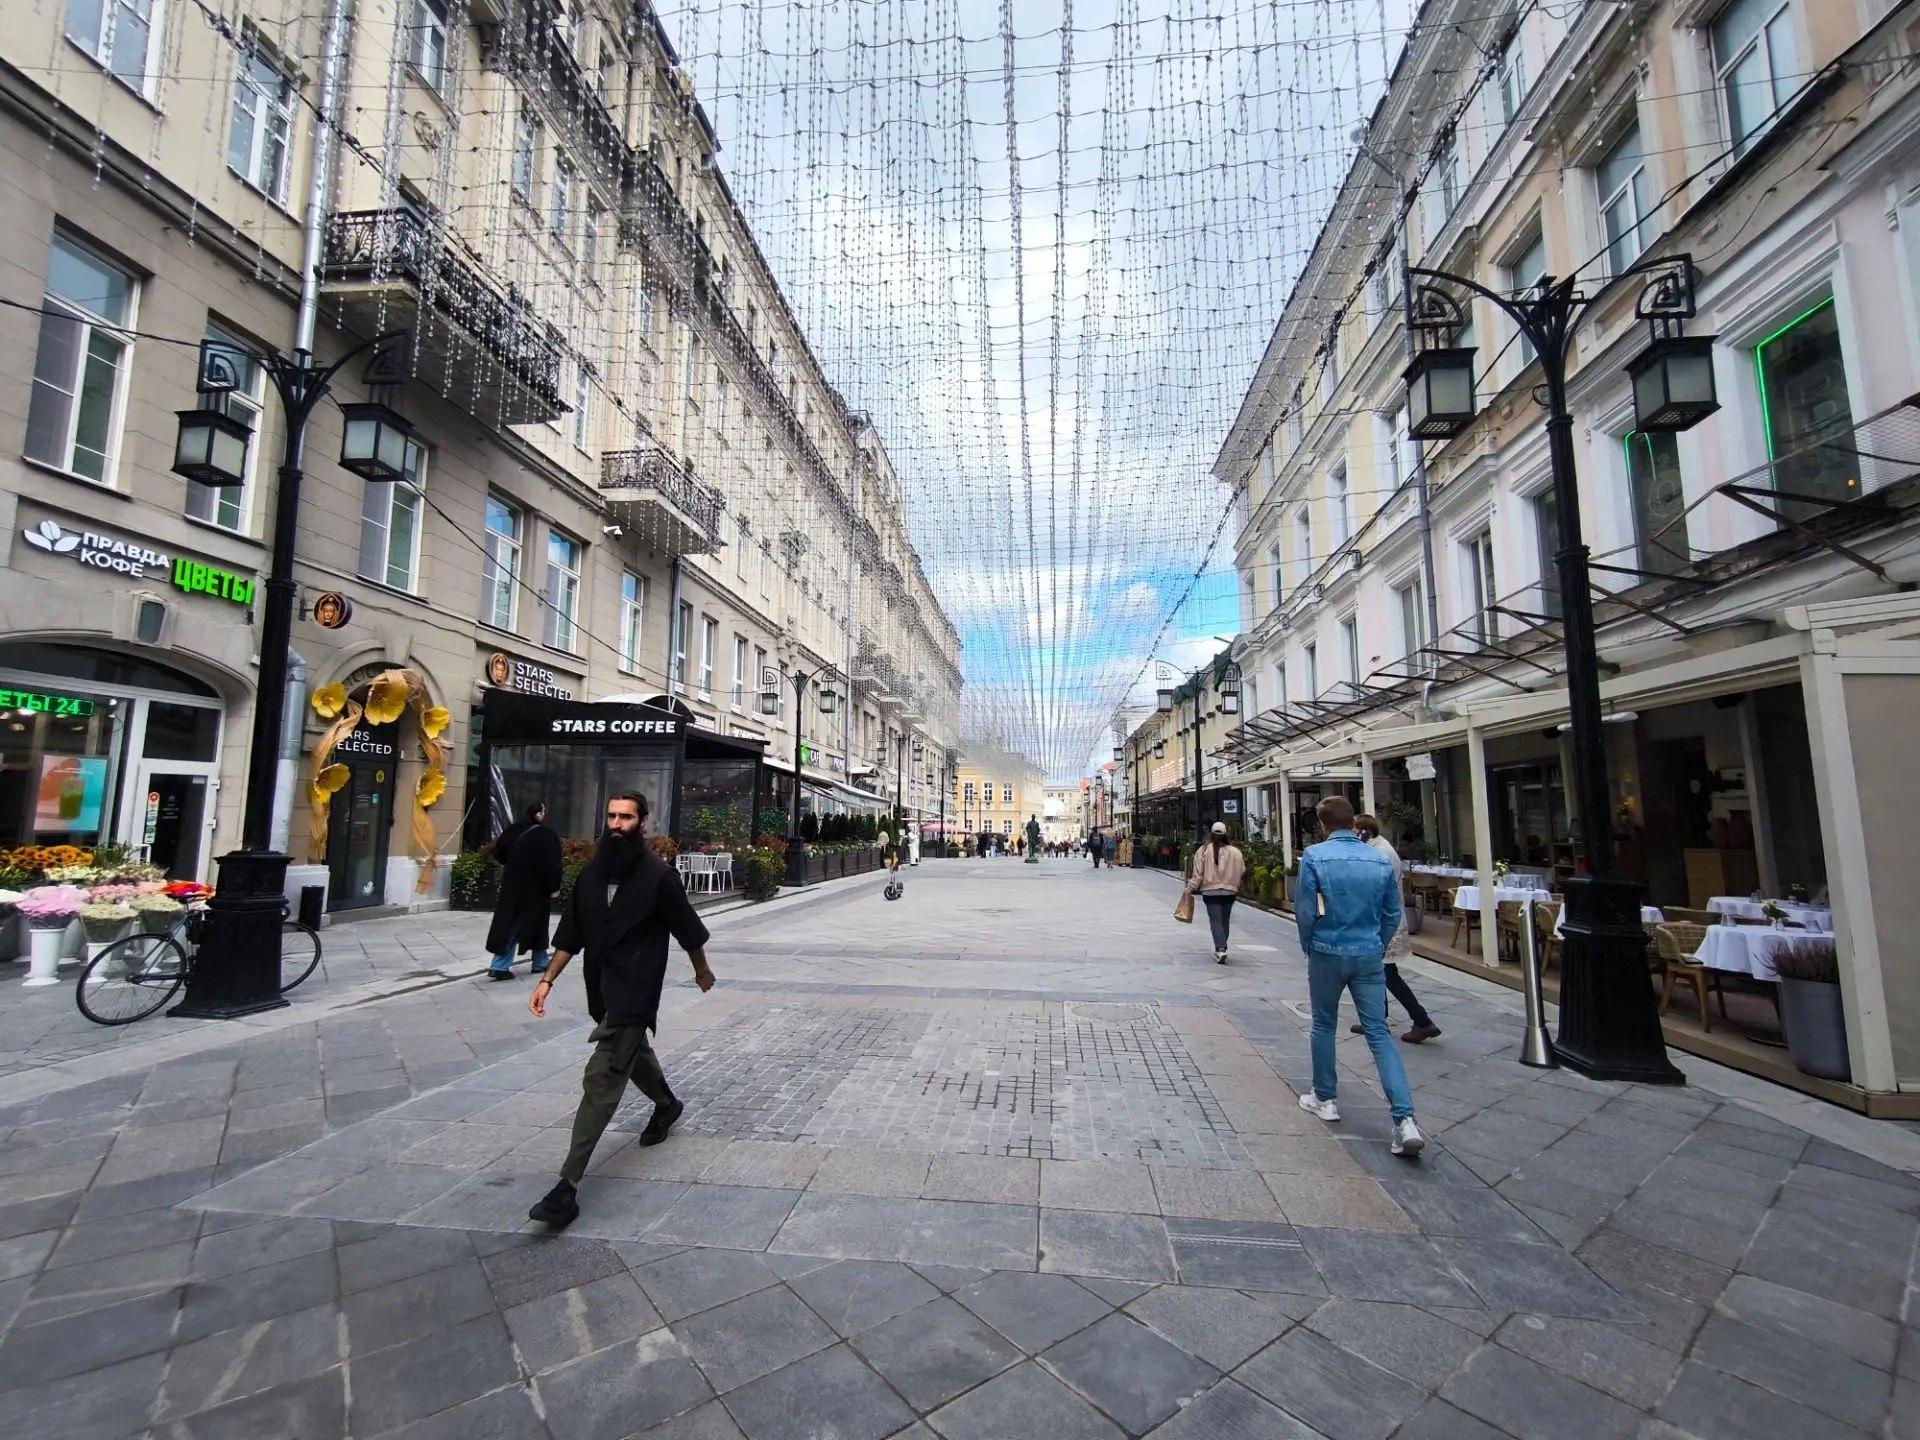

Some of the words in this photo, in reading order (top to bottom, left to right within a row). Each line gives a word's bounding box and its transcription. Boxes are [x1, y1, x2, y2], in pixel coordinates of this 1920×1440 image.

[83, 532, 170, 567] ПРАВДА
[81, 548, 144, 578] КОФЕ
[174, 559, 255, 604] ЦВЕТЫ
[516, 662, 554, 683] STARS
[515, 676, 573, 701] SELECTED
[56, 697, 80, 714] 24
[552, 719, 606, 733] STARS
[610, 720, 676, 733] COFFEE
[337, 741, 392, 755] ELECTED
